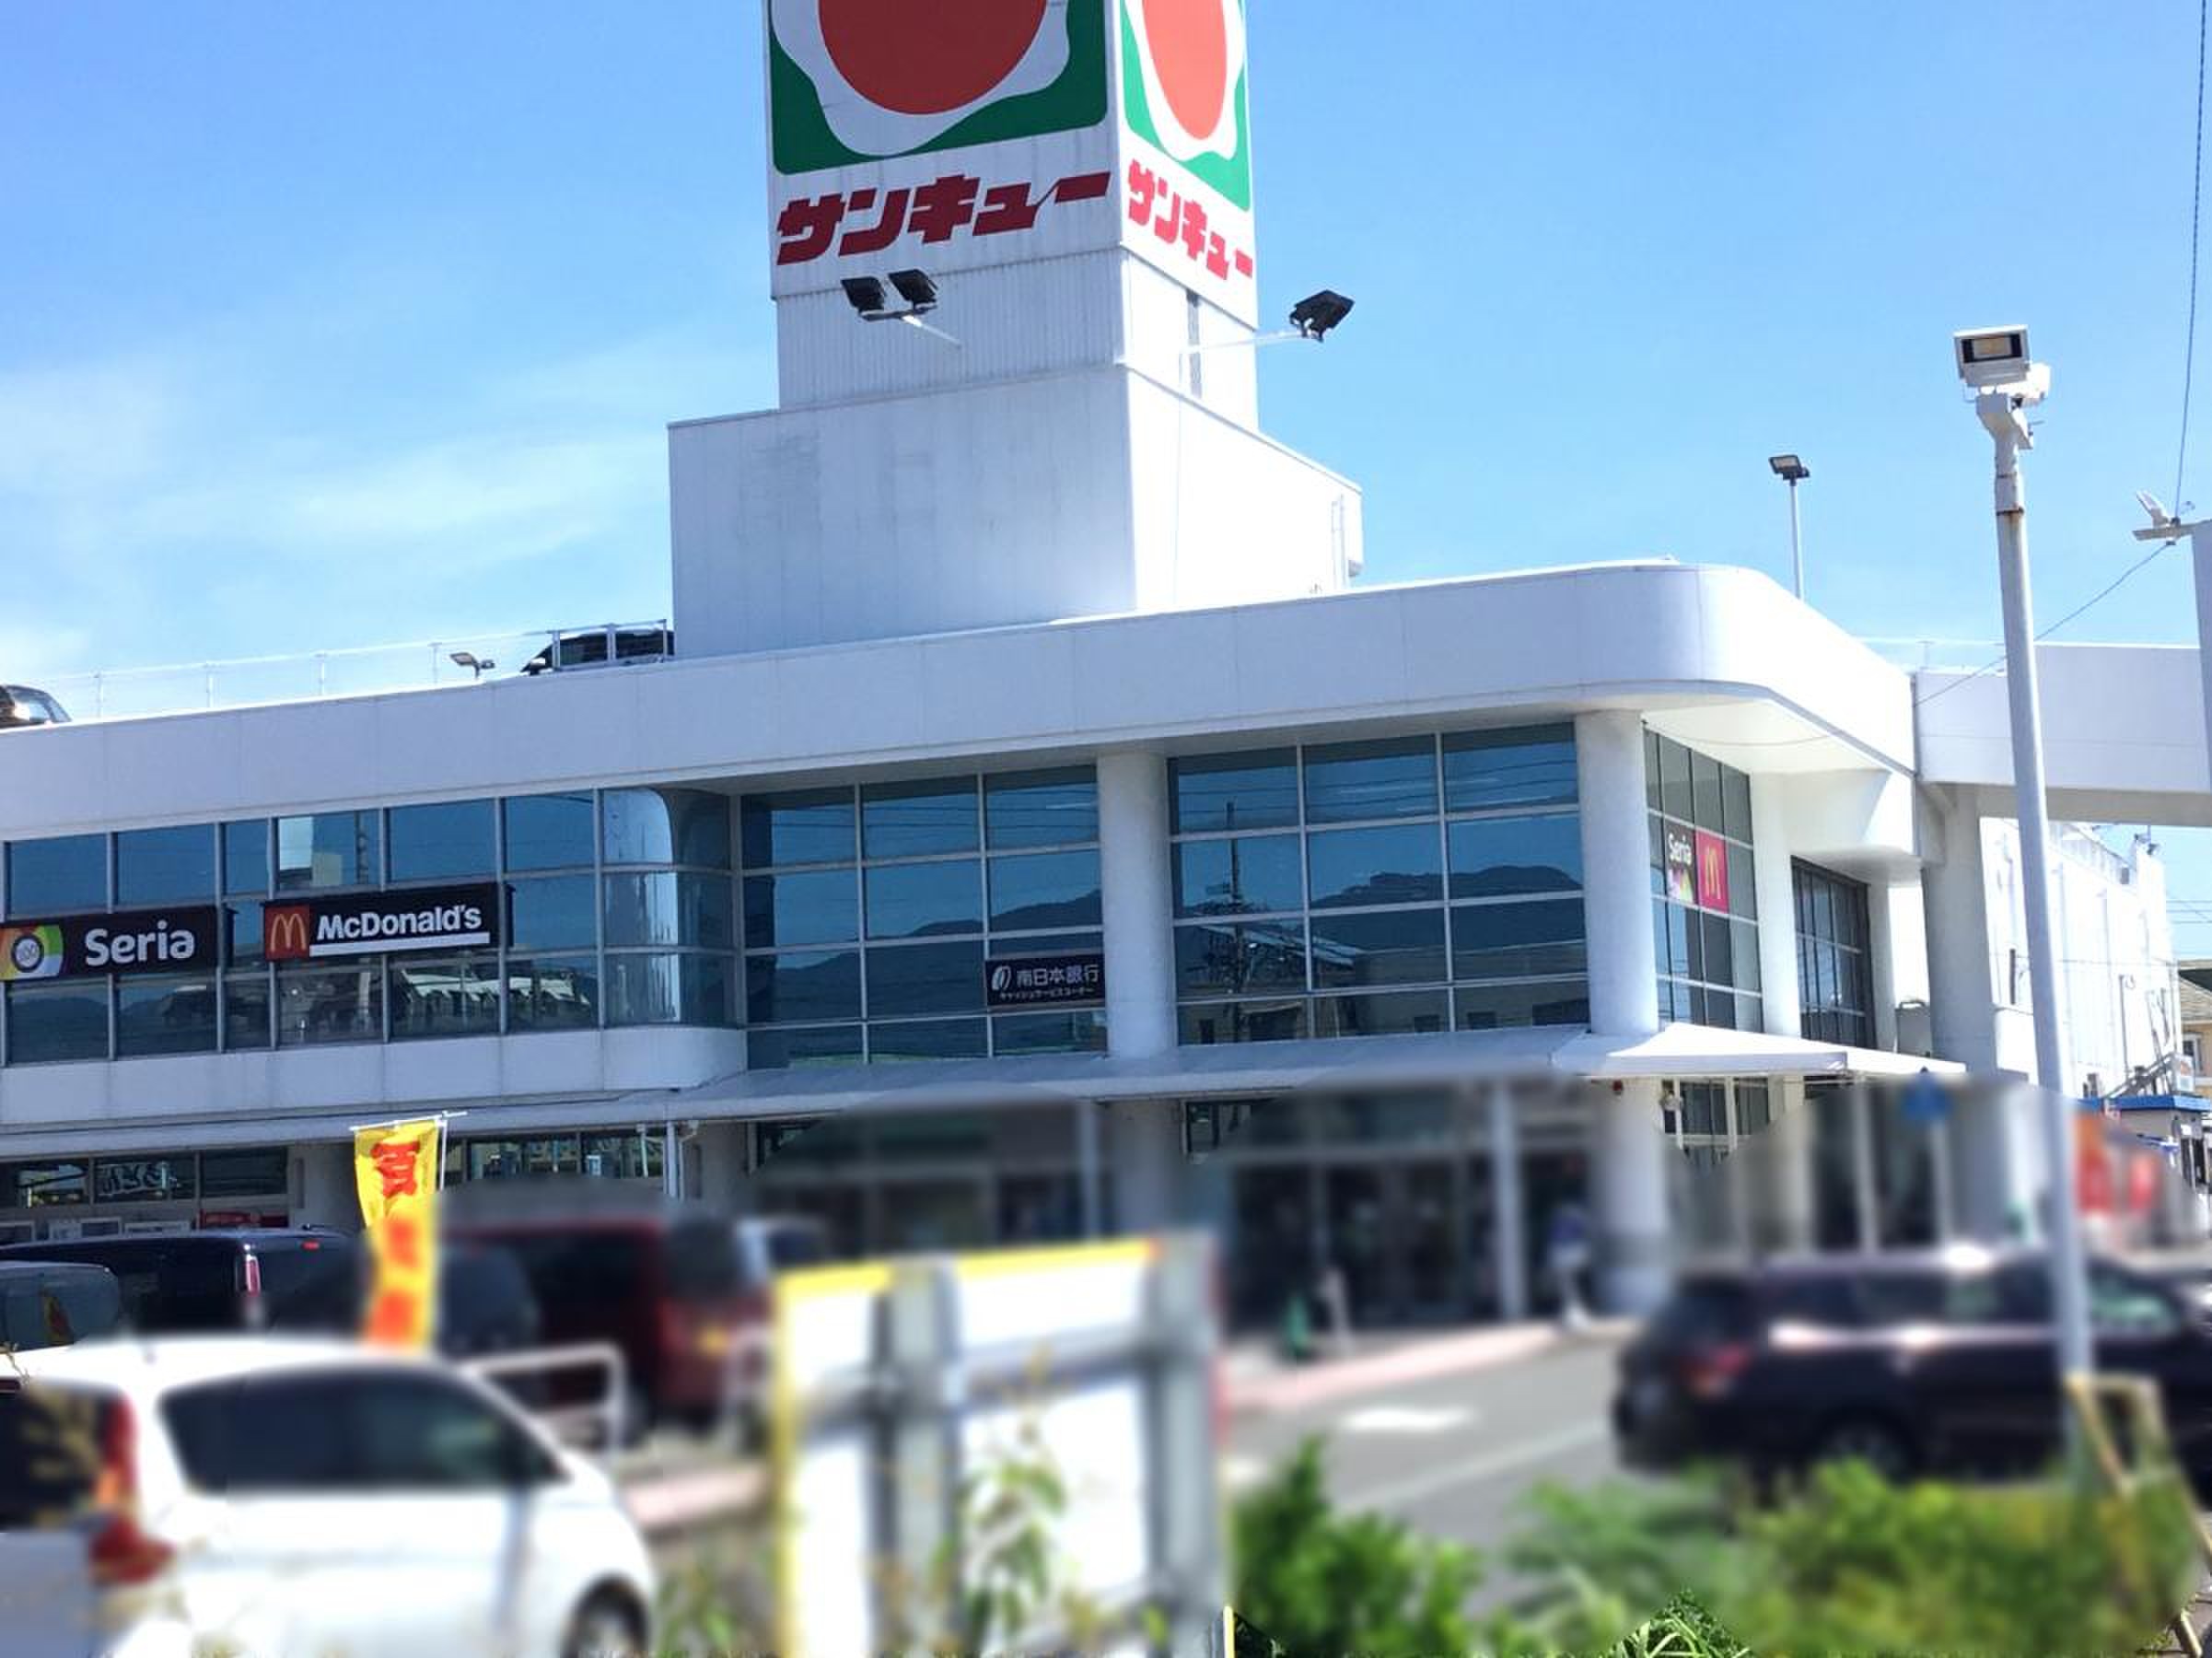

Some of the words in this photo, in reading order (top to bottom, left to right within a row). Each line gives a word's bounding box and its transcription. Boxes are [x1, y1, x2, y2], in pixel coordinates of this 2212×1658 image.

[775, 171, 1111, 266] サンキュー
[1128, 158, 1253, 281] サンキュー
[1668, 832, 1693, 866] Seria
[85, 919, 195, 966] Seria
[316, 904, 482, 941] McDonald's
[1016, 963, 1100, 987] 南日本銀行
